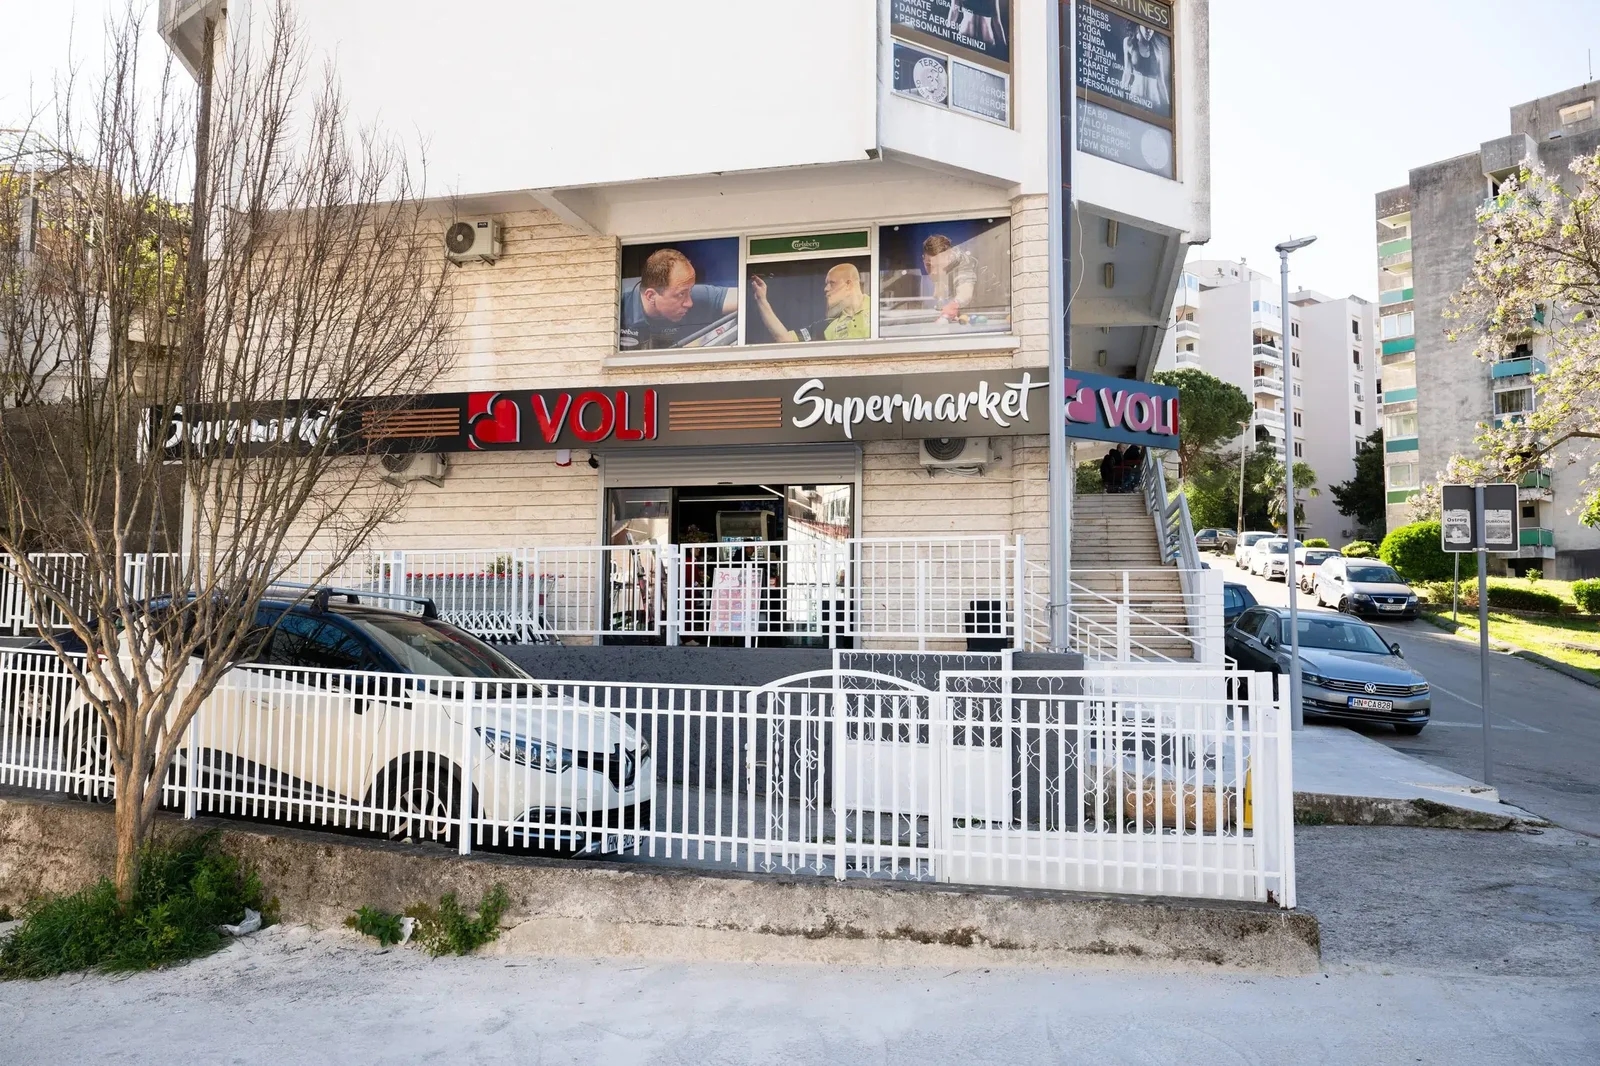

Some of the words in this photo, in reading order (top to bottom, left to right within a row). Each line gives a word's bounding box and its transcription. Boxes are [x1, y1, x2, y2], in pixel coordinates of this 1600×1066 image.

[900, 2, 927, 19] DANCE
[1082, 5, 1109, 22] FITNESS
[900, 14, 950, 39] PERSONALNI
[952, 31, 986, 51] TRENINZI
[1082, 16, 1111, 32] AEROBIC
[1082, 23, 1101, 37] YOGA
[1082, 32, 1106, 48] ZUMBA
[1082, 41, 1117, 61] BRAZILIAN
[1082, 51, 1093, 60] JIU
[1094, 54, 1111, 66] JITSU
[919, 59, 943, 73] TERZO
[1082, 58, 1109, 74] KARATE
[1082, 68, 1106, 82] DANCE
[1106, 77, 1134, 92] AEROBI
[1082, 77, 1124, 98] PERSONALNI
[1125, 91, 1153, 109] TRENINZI
[1083, 127, 1101, 139] STEP
[1101, 134, 1131, 150] AEROBIC
[1083, 139, 1098, 150] GYM
[1100, 144, 1119, 157] STICK
[791, 240, 820, 250] Carlsberg
[531, 388, 658, 443] VOLI
[792, 372, 1050, 439] Supermarket
[1099, 386, 1178, 436] VOLI
[1353, 699, 1363, 707] HN
[1367, 700, 1391, 710] CA828
